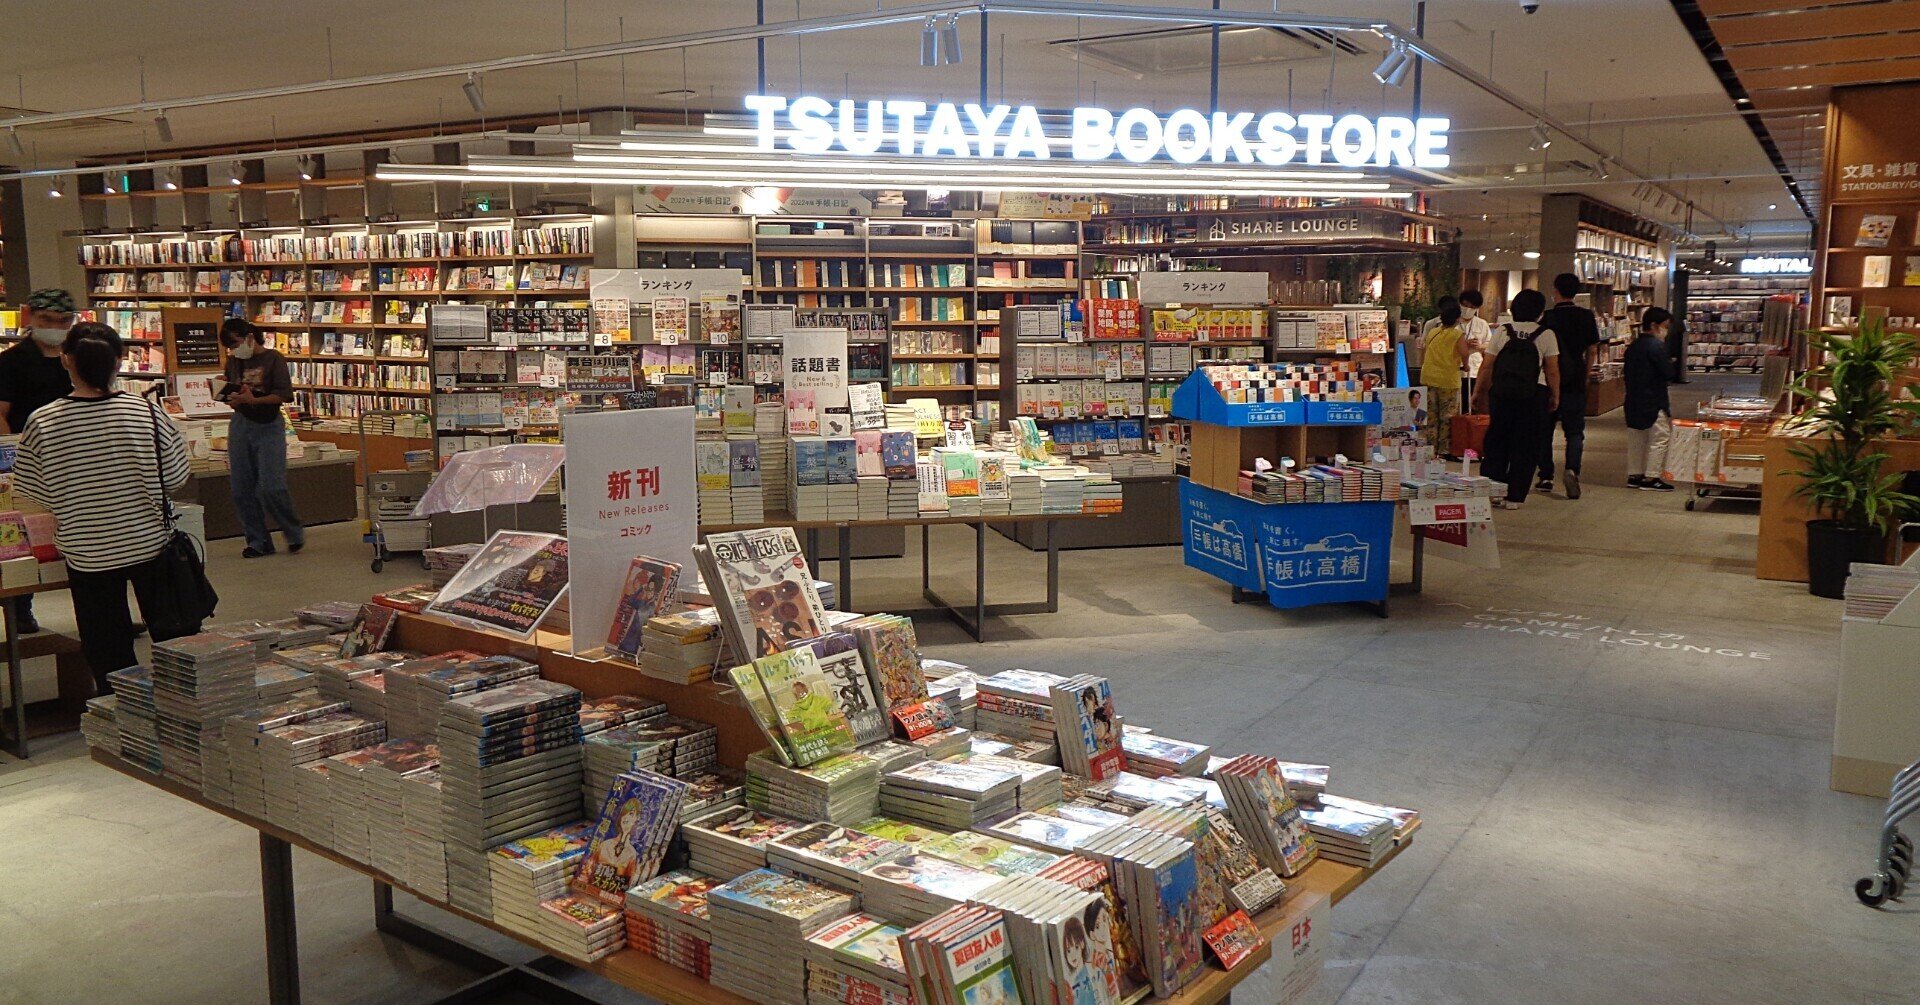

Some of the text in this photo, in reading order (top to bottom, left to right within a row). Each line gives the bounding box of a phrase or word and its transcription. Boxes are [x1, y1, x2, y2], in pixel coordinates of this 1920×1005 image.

[744, 95, 1452, 169] TSUTAYA BOOKSTORE
[1842, 162, 1919, 179] 文具・雑貨
[1231, 218, 1359, 235] SHARE LOUNGE
[640, 279, 693, 291] ランキング
[1182, 282, 1227, 292] ランキング
[591, 367, 630, 377] 直木賞
[791, 357, 841, 373] 話題書
[1249, 412, 1285, 422] 手帳は高橋
[1329, 412, 1363, 420] 手帳は高橋
[607, 466, 661, 501] 新刊
[599, 503, 670, 520] New Releases
[620, 524, 652, 538] コミック
[1486, 606, 1591, 620] レンタル
[1473, 614, 1685, 641] GAME/トレカ
[1461, 621, 1772, 661] SHARE LOUNGE
[763, 650, 814, 678] ルックバック
[739, 671, 757, 686] ルッ
[952, 928, 1003, 968] 夏目友人帳
